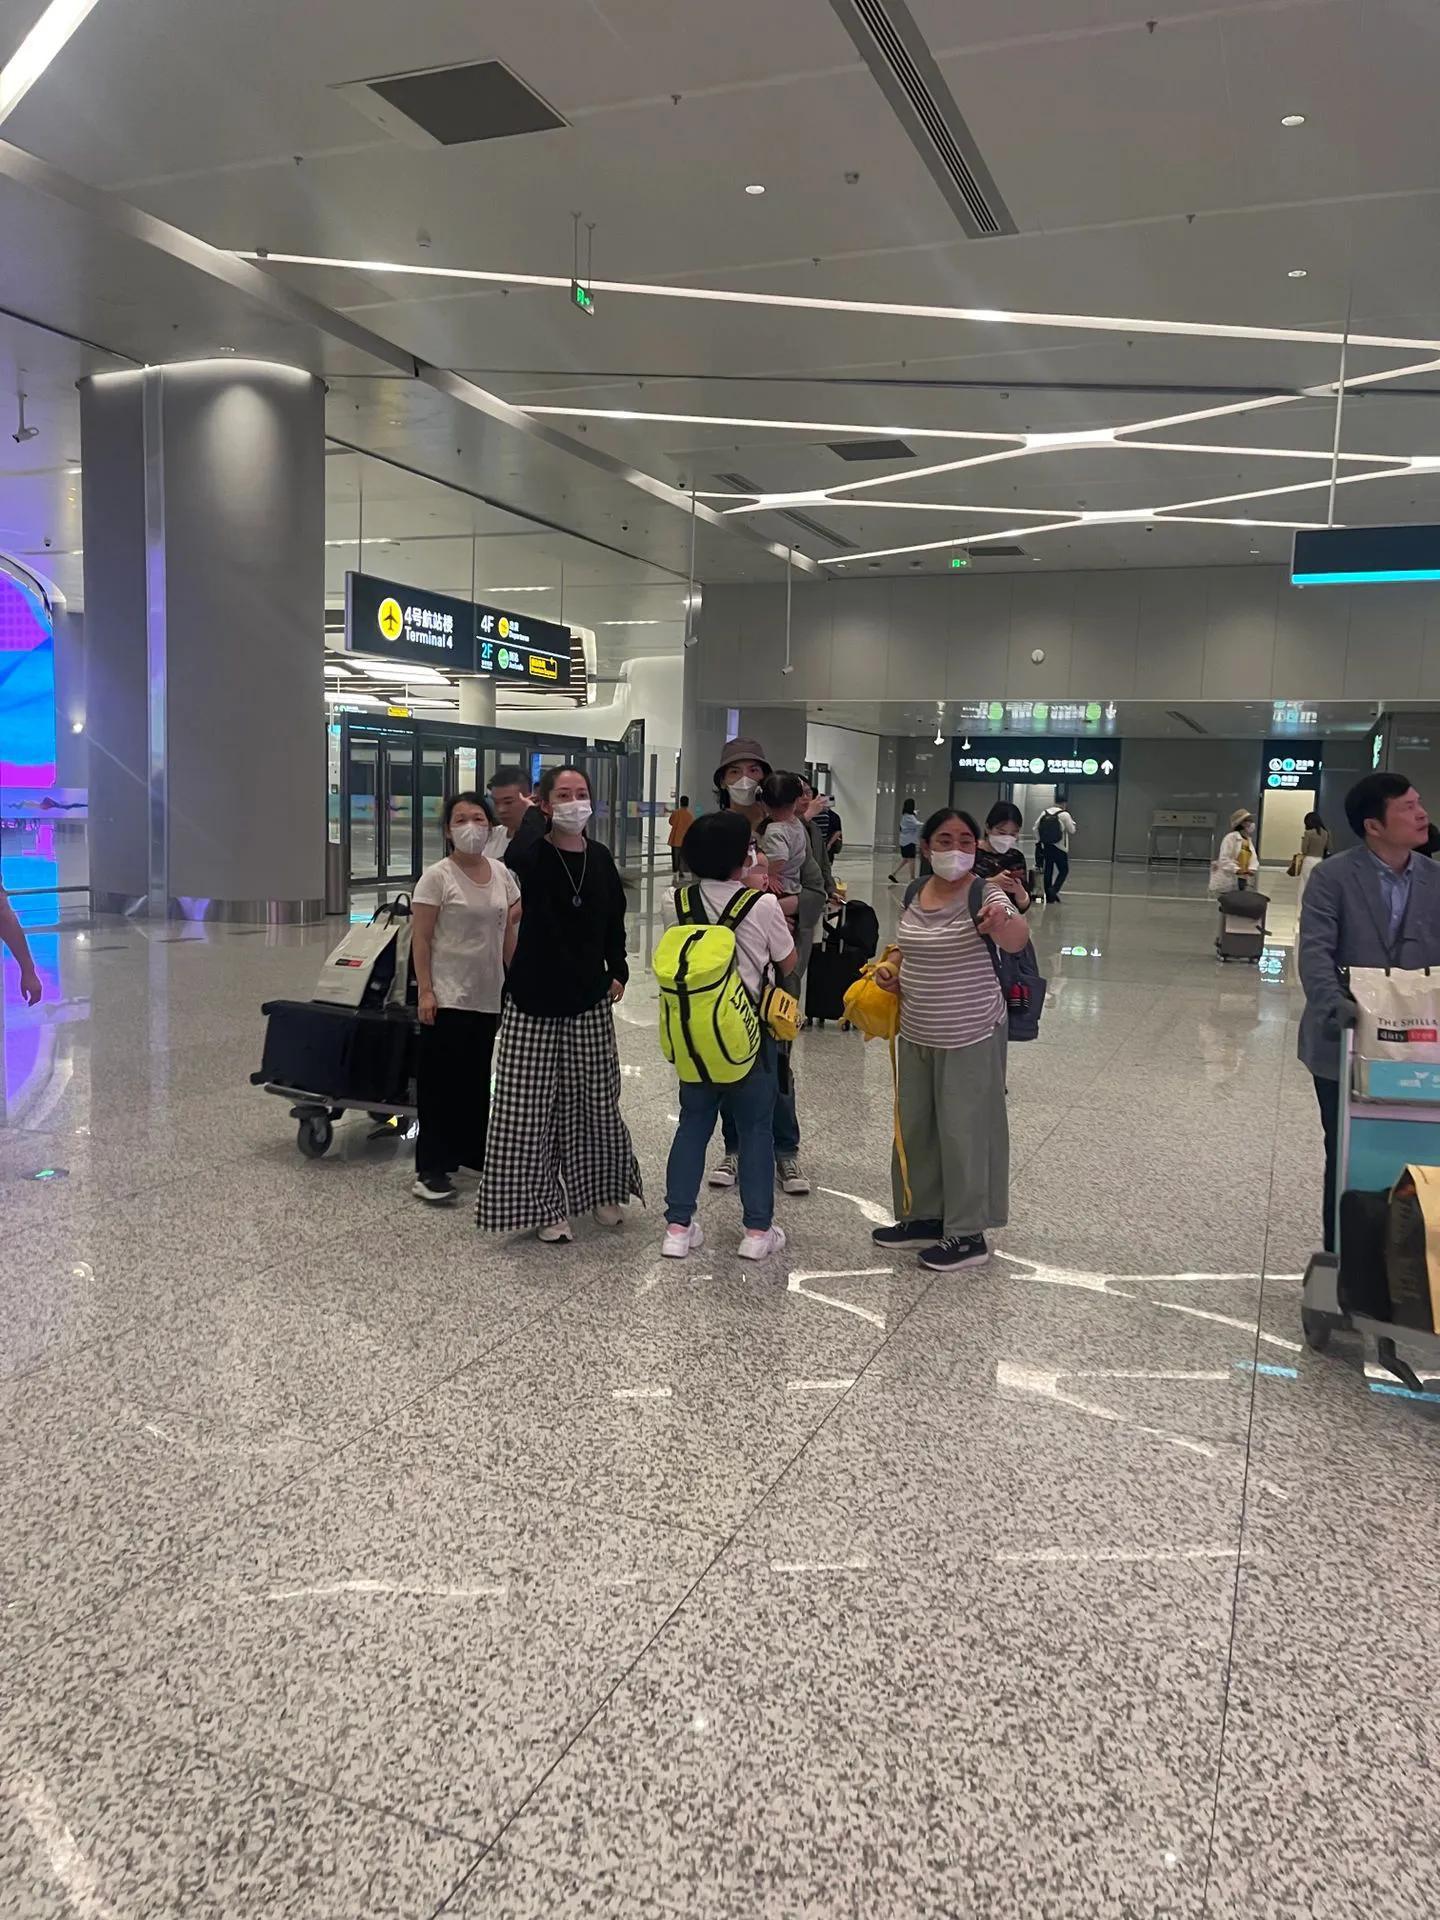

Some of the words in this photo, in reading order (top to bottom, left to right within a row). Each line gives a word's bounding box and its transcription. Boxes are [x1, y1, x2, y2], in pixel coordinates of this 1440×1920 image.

[404, 606, 453, 633] 4号航站楼
[480, 615, 495, 633] 4F
[404, 625, 446, 648] Terminal
[447, 635, 453, 649] 4
[481, 643, 494, 659] 2F
[1377, 1017, 1397, 1027] THE
[1401, 1018, 1439, 1027] SHILLA
